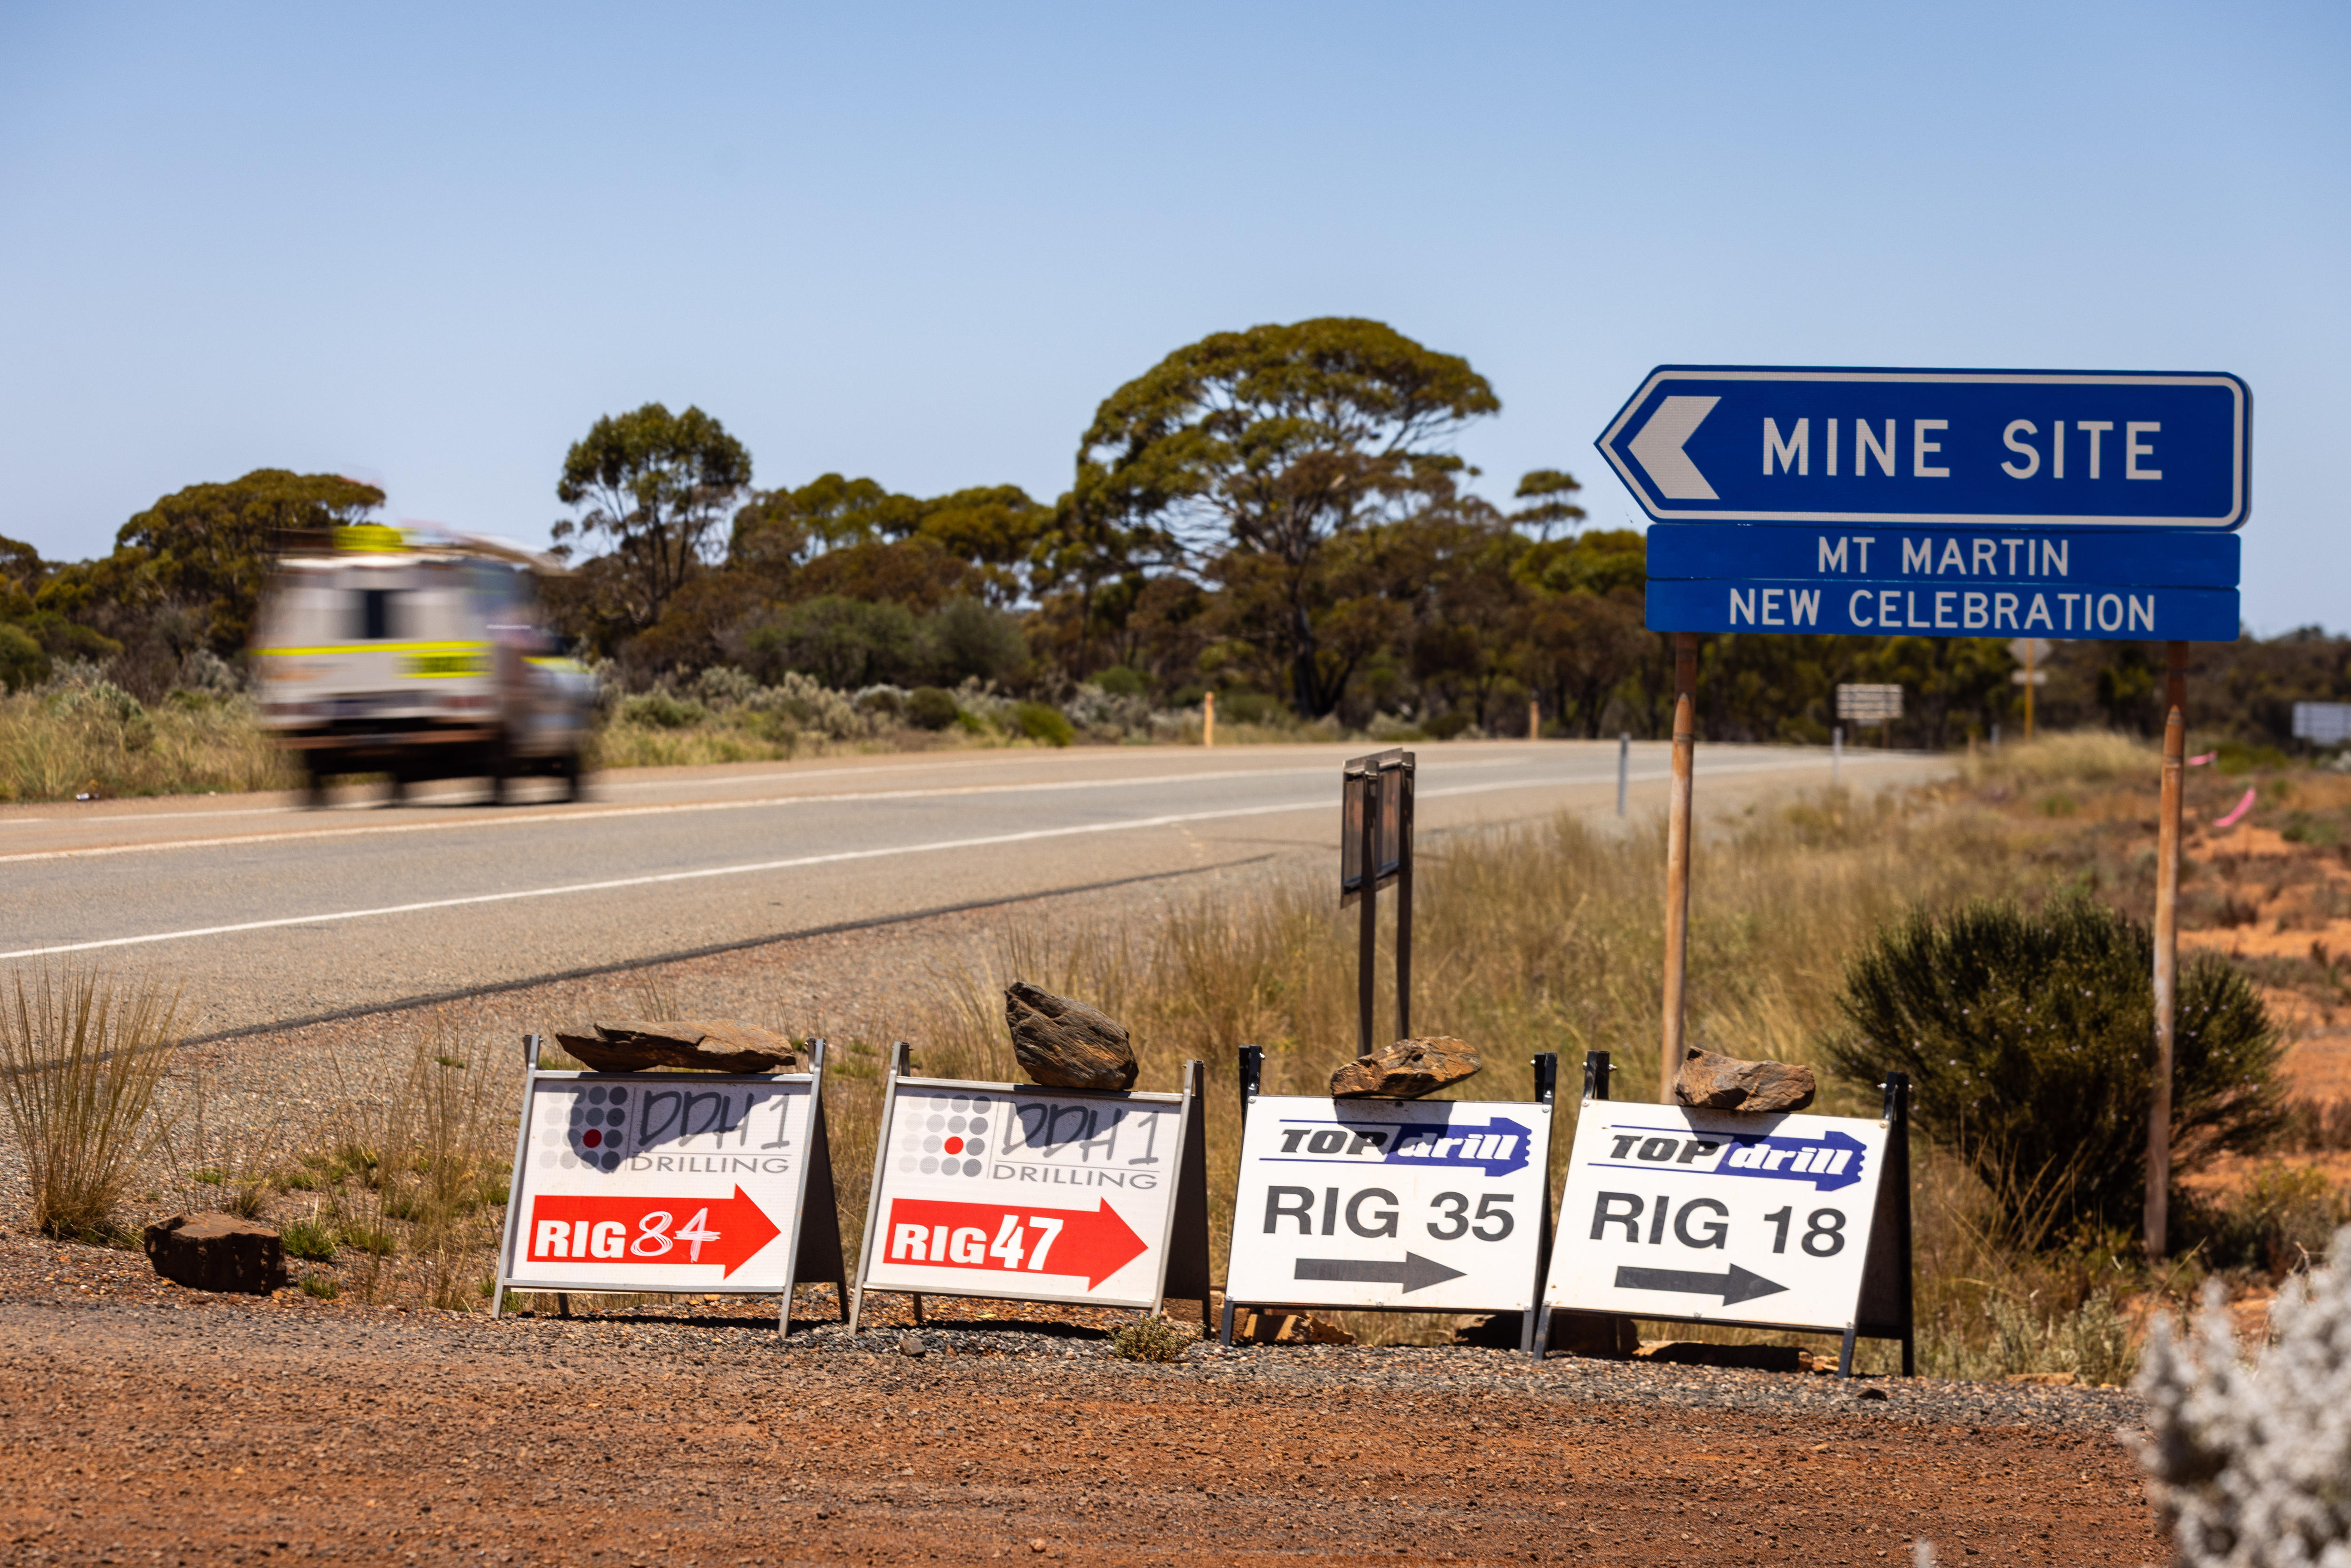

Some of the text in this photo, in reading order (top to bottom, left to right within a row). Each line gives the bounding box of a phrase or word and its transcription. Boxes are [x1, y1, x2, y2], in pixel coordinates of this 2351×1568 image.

[1762, 417, 2162, 480] MINE SITE
[1818, 536, 2069, 577] MT MARTIN
[1729, 588, 2155, 631] NEW CELEBRATION
[631, 1156, 789, 1174] DRILLING
[993, 1164, 1158, 1190] DRILLING
[1263, 1185, 1514, 1242] RIG 35
[1590, 1191, 1846, 1257] RIG 18
